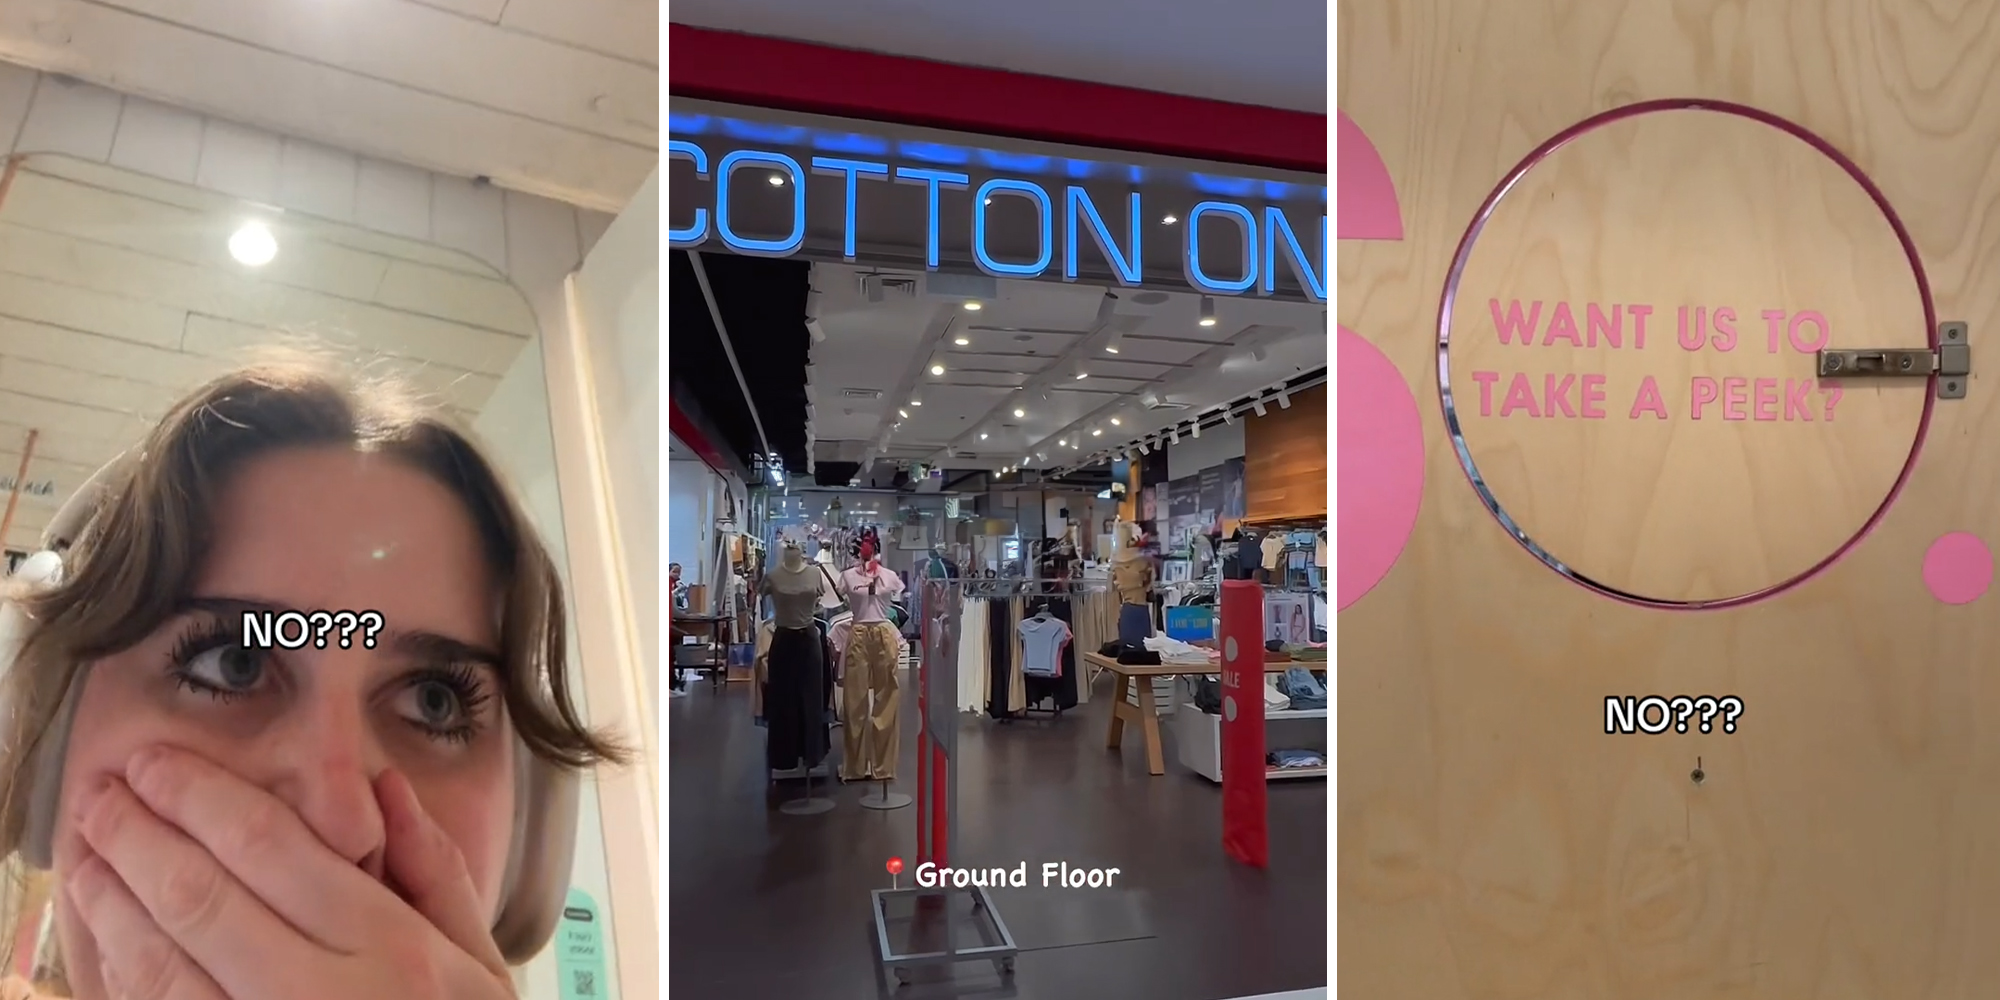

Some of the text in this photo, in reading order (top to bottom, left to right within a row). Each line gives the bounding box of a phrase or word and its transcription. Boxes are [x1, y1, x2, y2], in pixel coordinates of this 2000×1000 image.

[1184, 201, 1327, 303] ON
[1489, 298, 1830, 354] WANT US TO
[1472, 371, 1845, 422] TAKE A PEEK?
